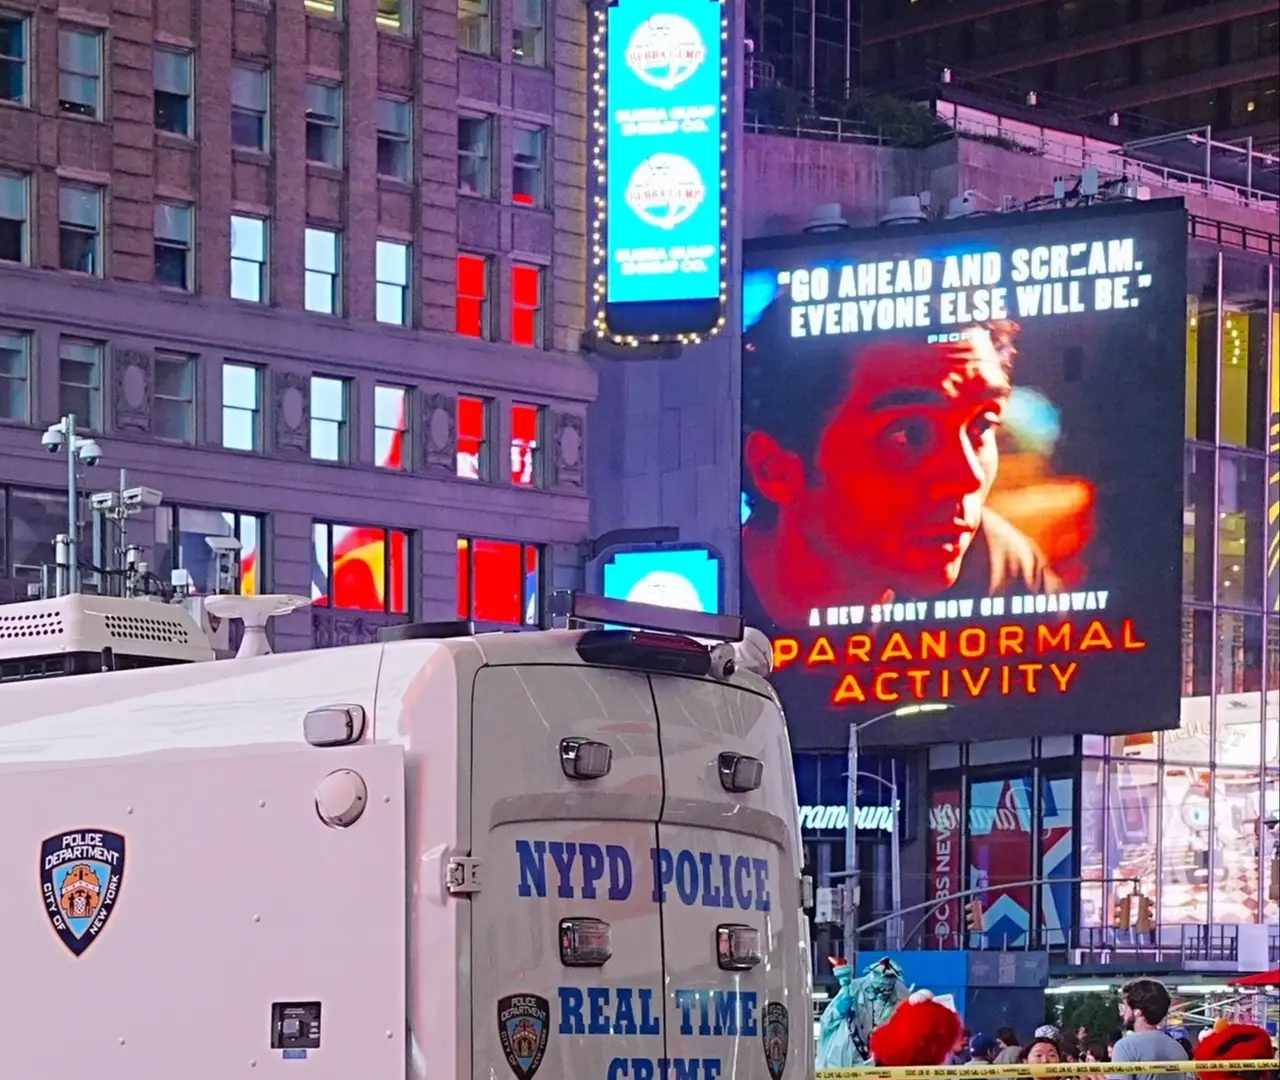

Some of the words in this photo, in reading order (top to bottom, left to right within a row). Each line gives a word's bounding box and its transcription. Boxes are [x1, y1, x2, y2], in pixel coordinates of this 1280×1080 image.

[838, 258, 932, 298] AHEAD
[941, 252, 1001, 288] AND
[790, 295, 930, 338] EVERYONE
[940, 288, 1007, 325] ELSE
[1016, 281, 1084, 318] WILL
[809, 608, 820, 627] A
[827, 606, 864, 625] NEW
[871, 602, 927, 623] STORY
[935, 599, 974, 619] NOW
[981, 597, 1004, 616] ON
[1012, 591, 1108, 614] BROADWAY
[774, 620, 1145, 668] PARANORMAL
[834, 662, 1078, 703] ACTIVITY
[45, 846, 119, 870] DEPARTMENT
[62, 832, 103, 848] POLICE
[515, 840, 633, 901] NYPD
[650, 848, 771, 912] POLICE
[43, 882, 57, 912] CITY
[53, 915, 66, 931] OF
[89, 908, 108, 935] NEW
[104, 874, 119, 905] YORK
[935, 878, 950, 919] CBS
[501, 1006, 546, 1021] DEPARTMENT
[511, 997, 537, 1007] POLICE
[558, 986, 660, 1035] REAL
[675, 990, 758, 1036] TIME
